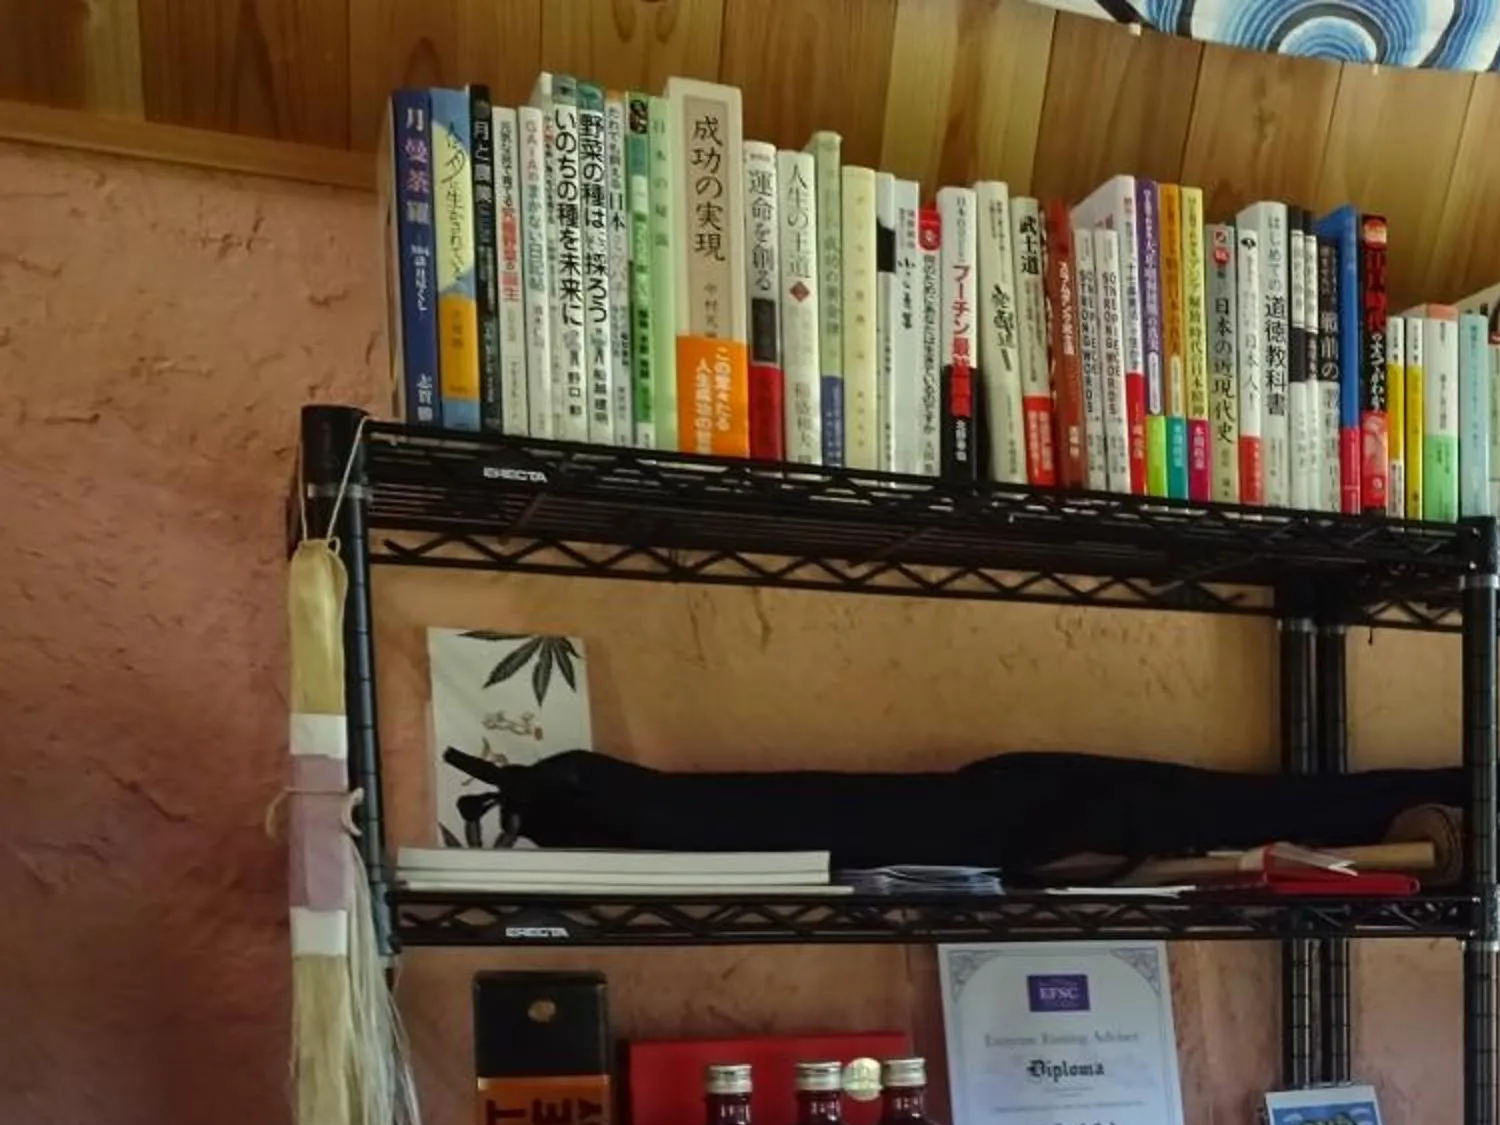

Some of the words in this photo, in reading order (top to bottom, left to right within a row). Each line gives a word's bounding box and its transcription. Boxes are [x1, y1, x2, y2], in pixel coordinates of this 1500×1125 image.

[554, 109, 584, 326] いのちの種を未来に
[691, 115, 726, 262] 成功の実現
[750, 169, 775, 291] 運命を創る
[1019, 215, 1039, 275] 武士道
[1026, 1060, 1106, 1083] Diploma
